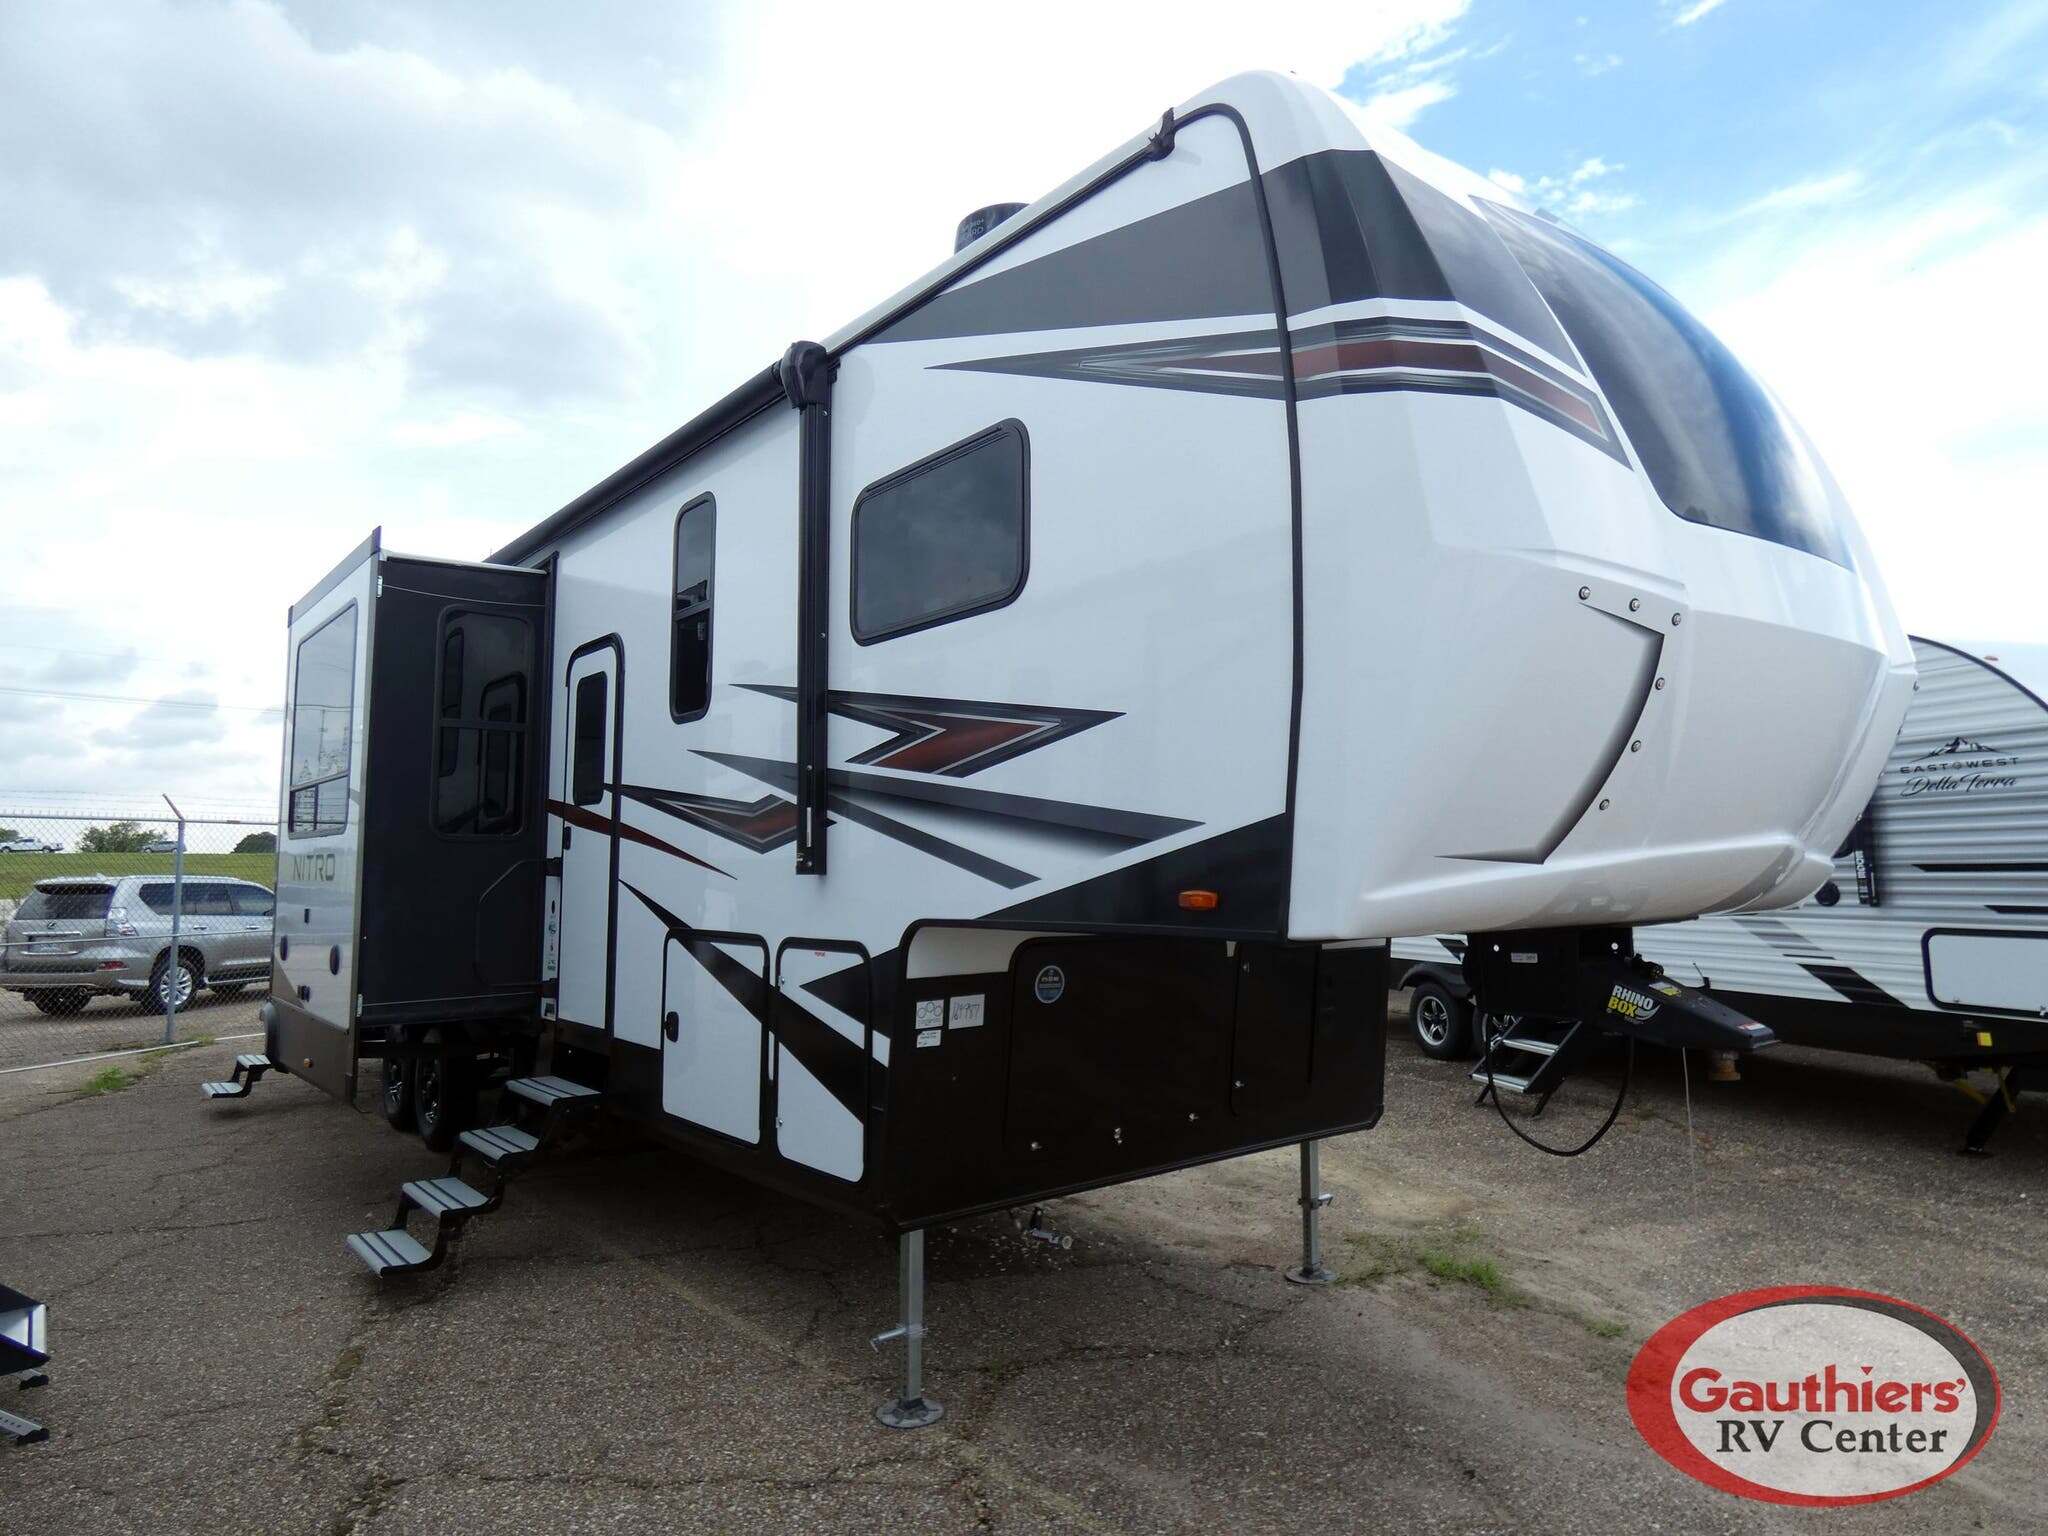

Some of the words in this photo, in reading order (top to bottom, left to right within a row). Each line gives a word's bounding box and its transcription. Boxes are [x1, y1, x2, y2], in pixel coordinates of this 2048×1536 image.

[1900, 775, 1958, 797] Della
[1960, 771, 2017, 793] Terra
[293, 853, 336, 881] NITRO
[1608, 996, 1637, 1017] BOX
[1612, 985, 1654, 1010] RHINO
